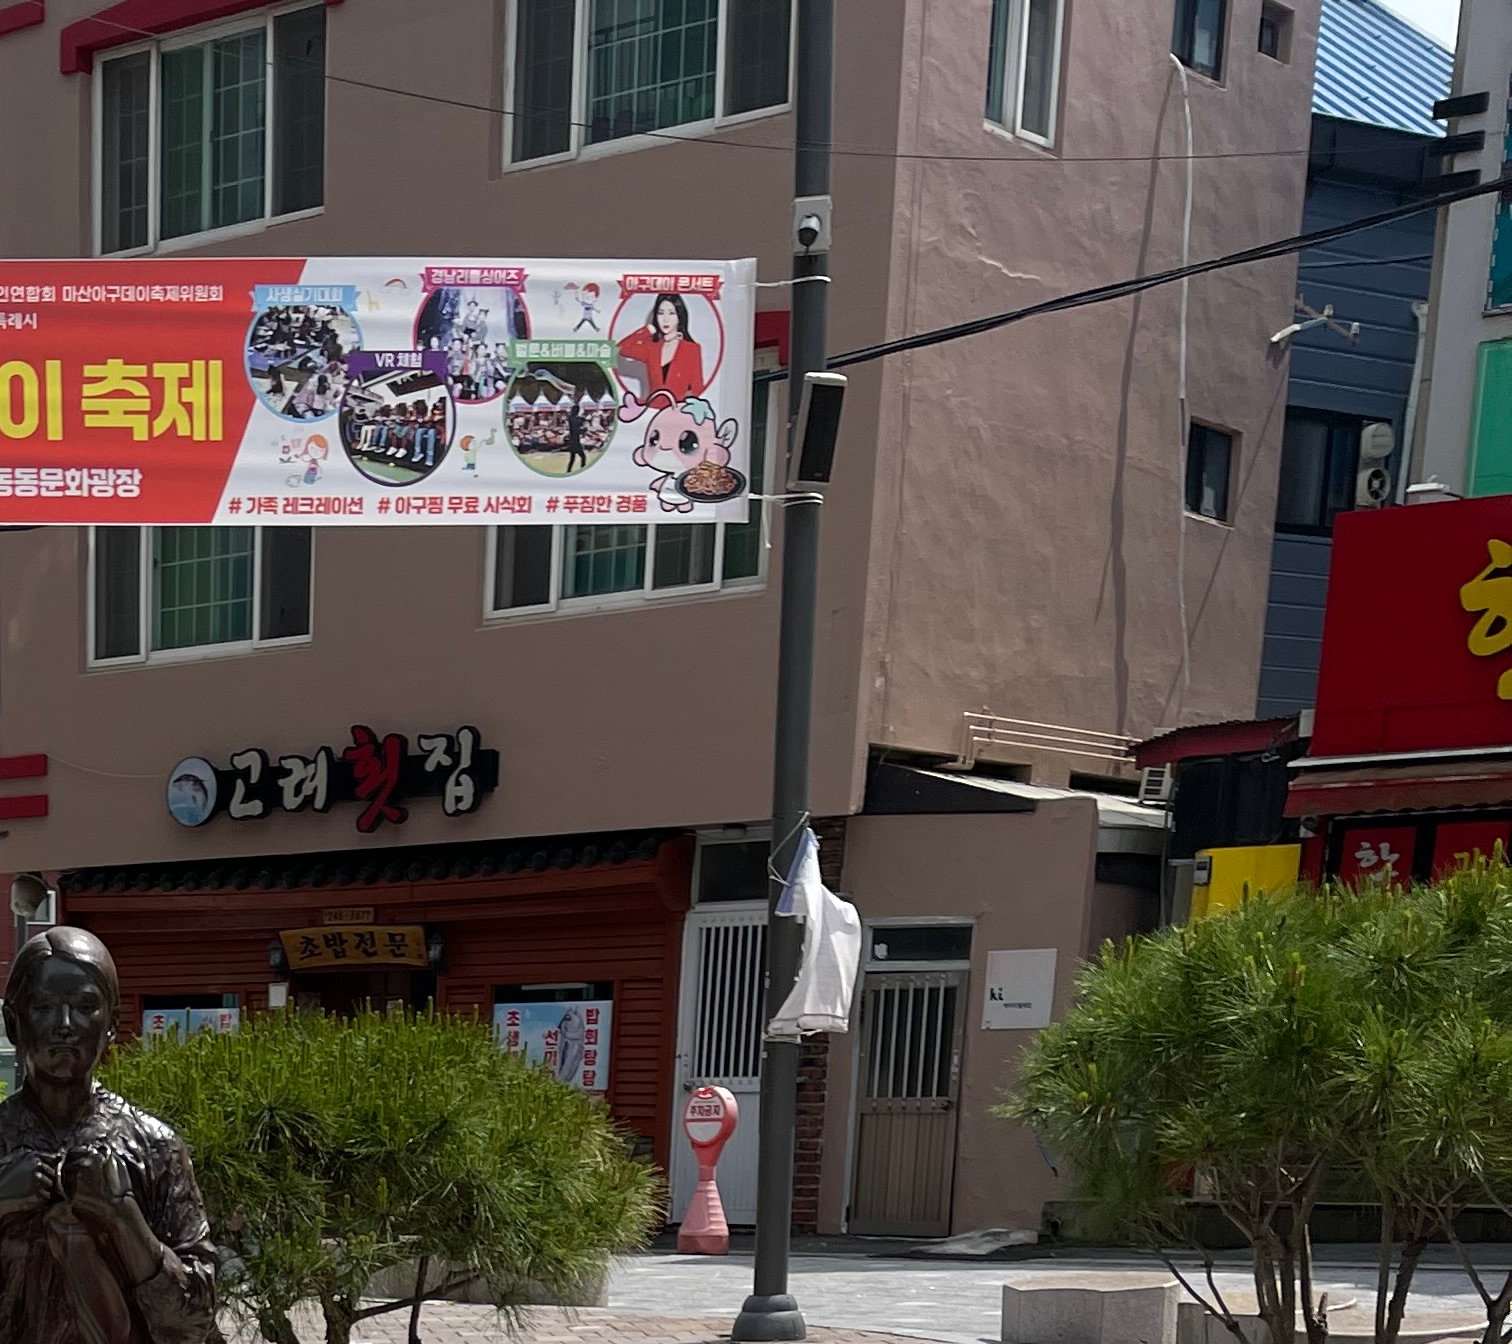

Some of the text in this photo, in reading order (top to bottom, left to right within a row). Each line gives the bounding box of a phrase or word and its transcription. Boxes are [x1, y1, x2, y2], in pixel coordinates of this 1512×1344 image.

[62, 285, 224, 303] 마산아구데이축제위원회
[626, 277, 714, 292] 아구데이 콘서트
[374, 352, 394, 368] VR
[81, 358, 224, 442] 축제
[245, 497, 278, 515] 가족
[282, 497, 364, 515] 레크레이션
[395, 497, 444, 515] 아구찜
[447, 497, 480, 515] 무료
[483, 496, 532, 515] 시식회
[563, 496, 611, 514] 푸짐한
[615, 495, 648, 513] 경품
[229, 725, 481, 833] 고래횟집
[298, 931, 409, 961] 초밥전문
